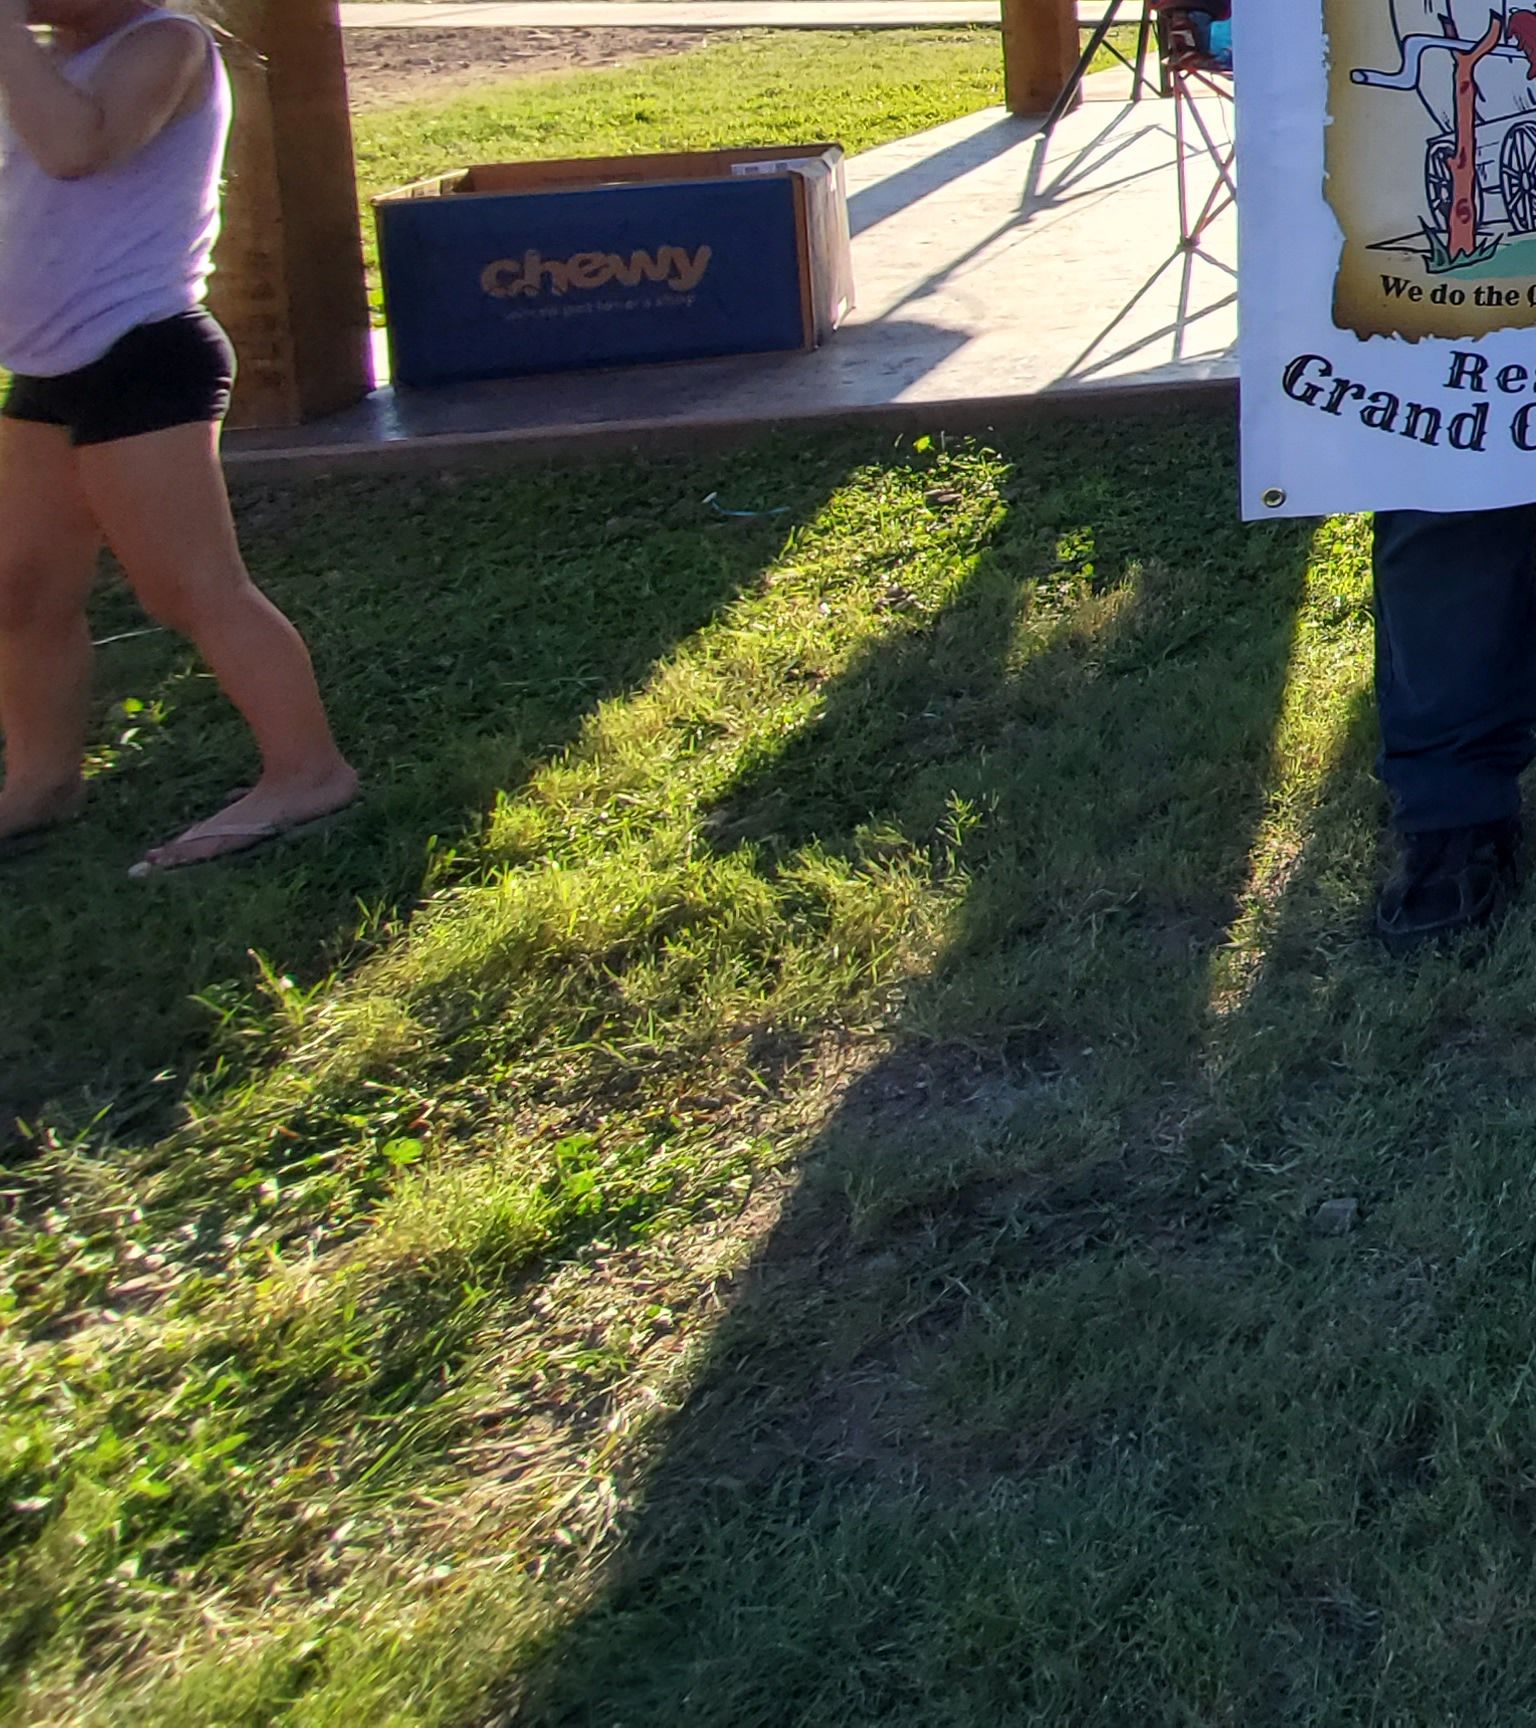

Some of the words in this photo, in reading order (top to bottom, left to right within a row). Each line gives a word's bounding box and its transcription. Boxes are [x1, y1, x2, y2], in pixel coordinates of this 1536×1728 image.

[480, 244, 713, 299] chewy
[1379, 274, 1423, 304] We
[1430, 281, 1466, 306] do
[1474, 282, 1519, 307] the
[1282, 352, 1490, 453] Grand
